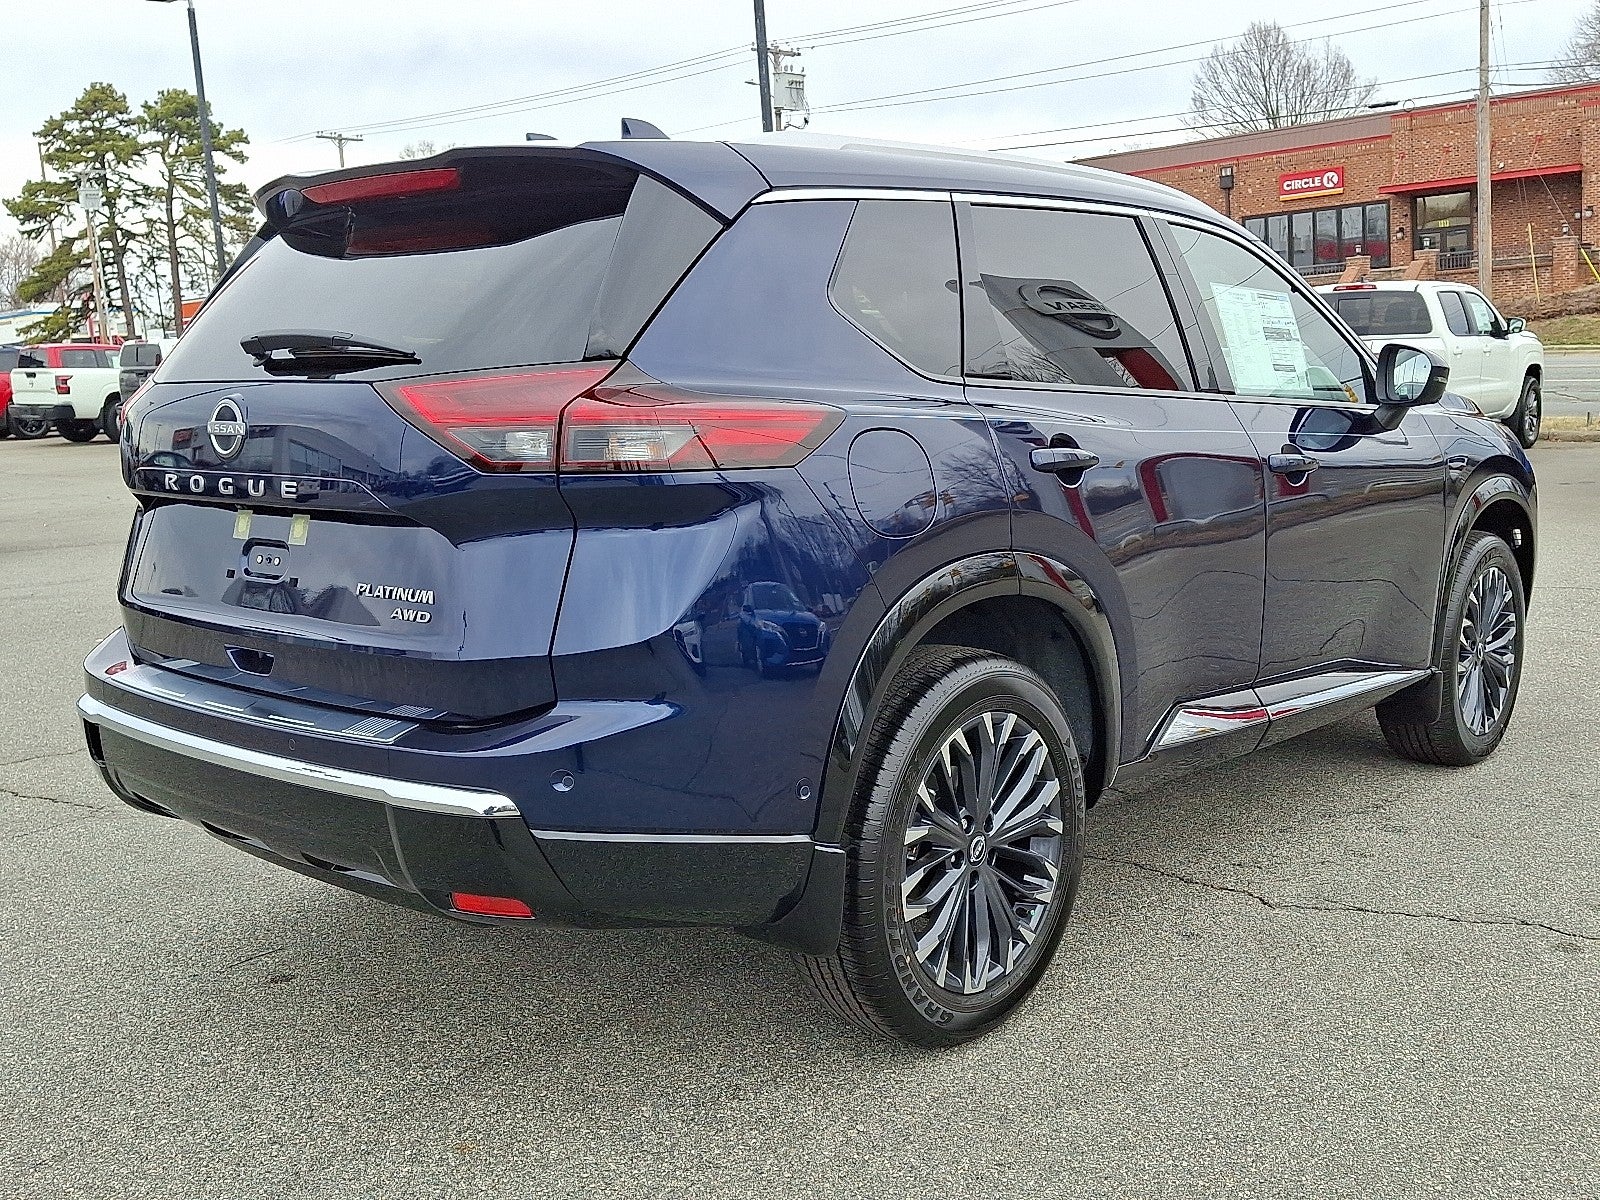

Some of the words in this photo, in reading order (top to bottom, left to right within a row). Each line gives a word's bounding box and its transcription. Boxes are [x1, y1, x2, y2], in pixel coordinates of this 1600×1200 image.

[1283, 176, 1321, 191] CIRCLE
[1325, 173, 1337, 186] K
[164, 473, 298, 499] ROGUE
[356, 582, 434, 605] PLATINUM
[390, 607, 431, 623] AWD
